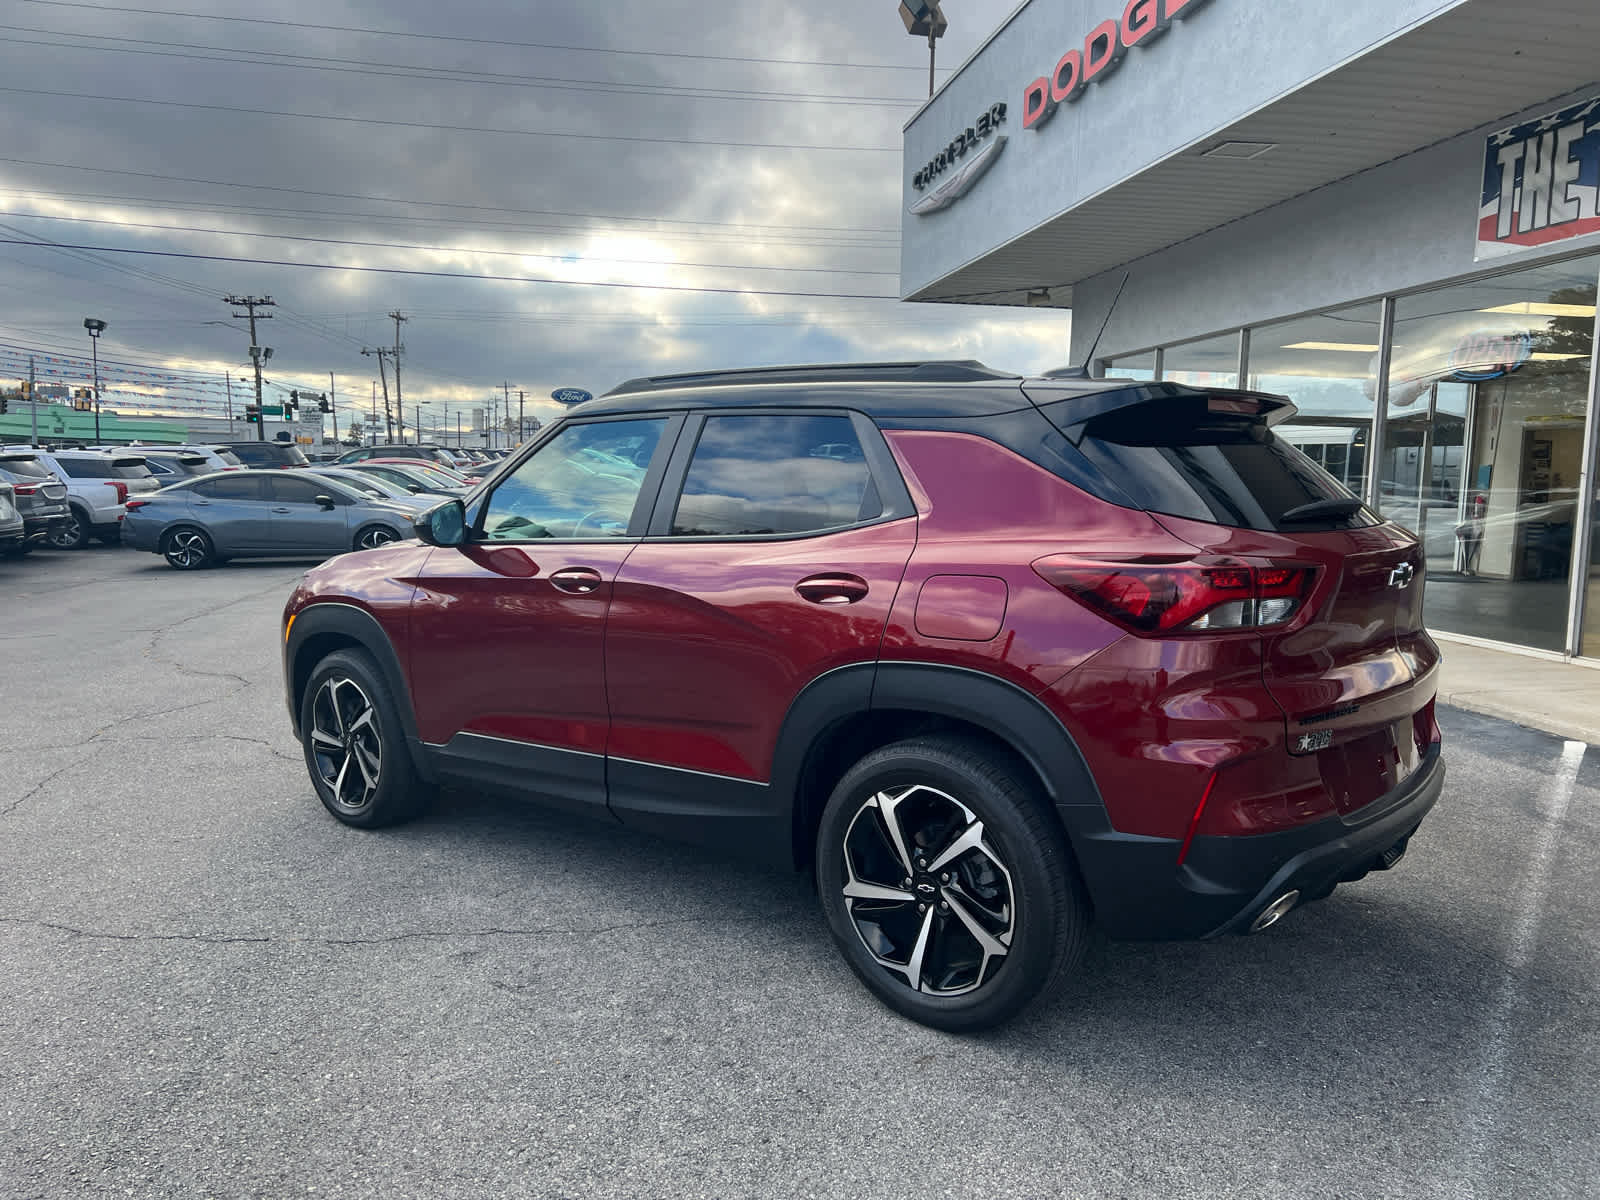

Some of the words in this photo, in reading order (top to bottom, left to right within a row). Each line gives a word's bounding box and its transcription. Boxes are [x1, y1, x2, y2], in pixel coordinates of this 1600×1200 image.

[1023, 0, 1191, 129] DODG
[1497, 120, 1584, 240] THE
[560, 391, 585, 401] Ford
